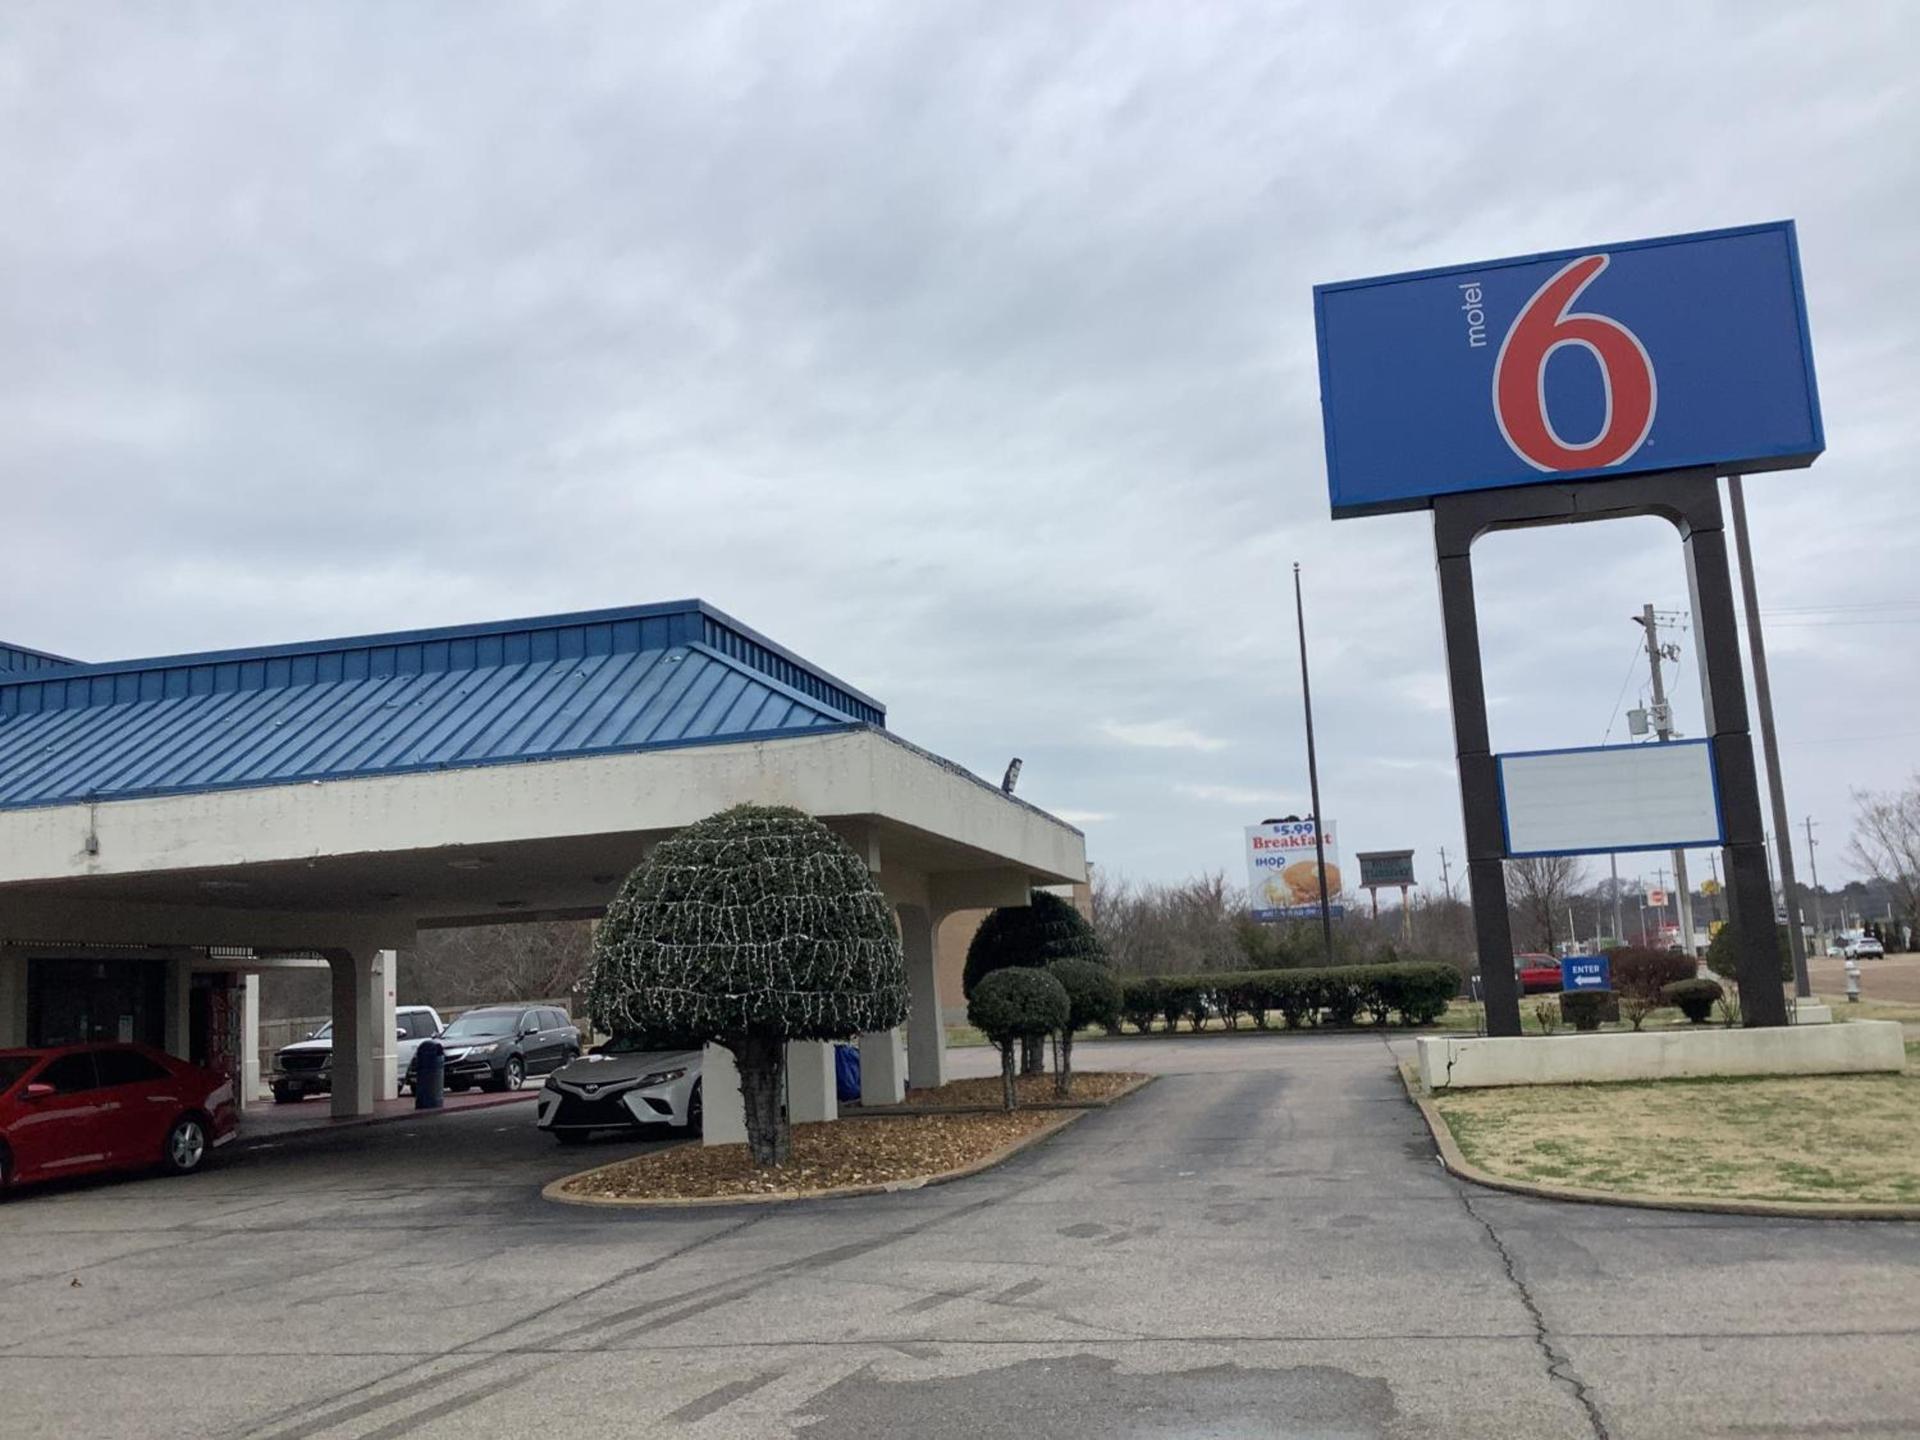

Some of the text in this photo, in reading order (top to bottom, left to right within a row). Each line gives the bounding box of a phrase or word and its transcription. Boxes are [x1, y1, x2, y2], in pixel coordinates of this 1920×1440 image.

[1459, 253, 1657, 472] motel 6
[1273, 823, 1313, 835] $5.99
[1252, 833, 1332, 849] Breakfat
[1572, 965, 1600, 974] ENTER
